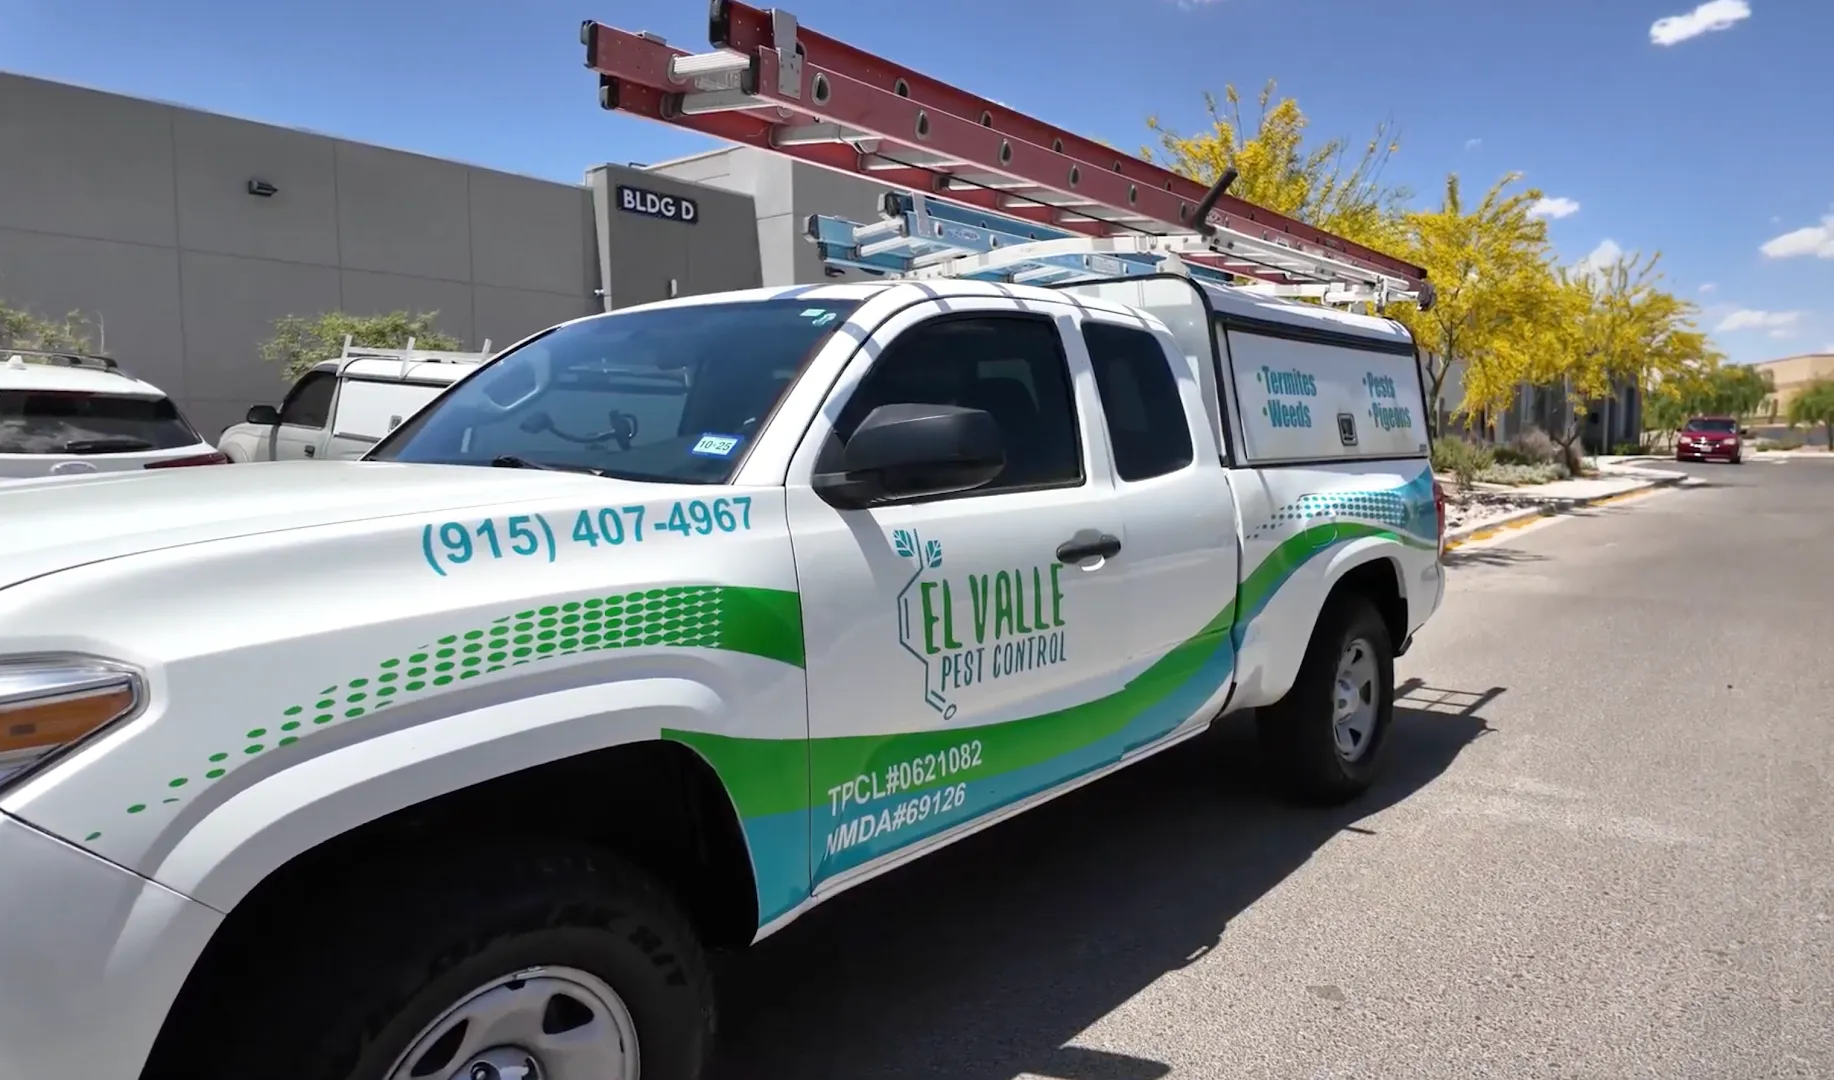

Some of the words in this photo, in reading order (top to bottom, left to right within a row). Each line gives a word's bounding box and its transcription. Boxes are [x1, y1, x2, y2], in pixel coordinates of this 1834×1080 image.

[623, 189, 676, 217] BLDG
[681, 200, 695, 220] D
[1261, 365, 1317, 397] Termites
[1366, 372, 1396, 399] Pests
[1267, 399, 1312, 428] Weeds
[1371, 402, 1412, 432] Pigeons
[422, 512, 556, 576] (915)
[572, 496, 752, 547] 407-4967
[920, 578, 963, 655] EL
[968, 563, 1066, 645] VALLE
[941, 648, 985, 692] PEST
[993, 630, 1067, 679] CONTROL
[828, 740, 983, 817] TPCL#0621082
[823, 782, 967, 862] NMDA#69126
